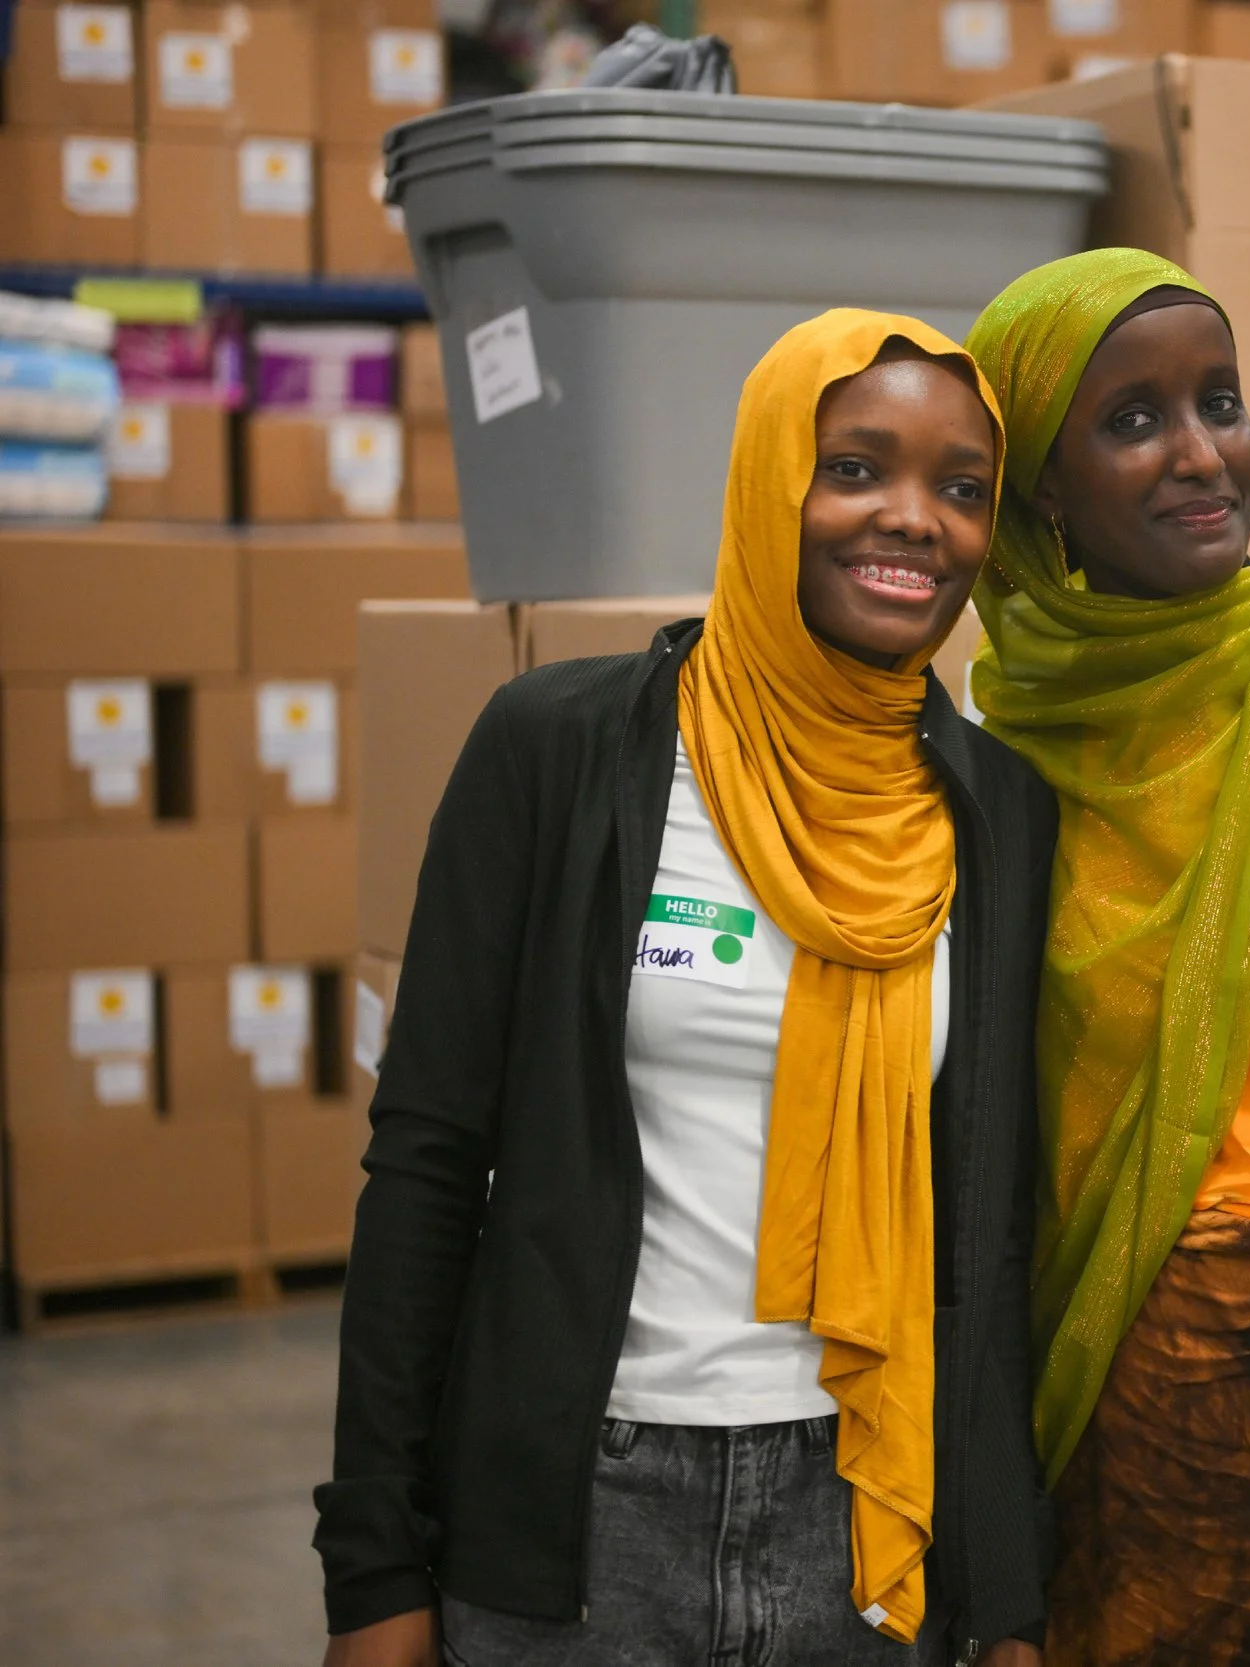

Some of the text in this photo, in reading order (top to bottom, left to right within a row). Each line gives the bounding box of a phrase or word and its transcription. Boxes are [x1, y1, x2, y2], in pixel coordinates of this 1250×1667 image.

[665, 899, 717, 918] HELLO
[668, 914, 681, 922] my
[682, 916, 705, 925] name
